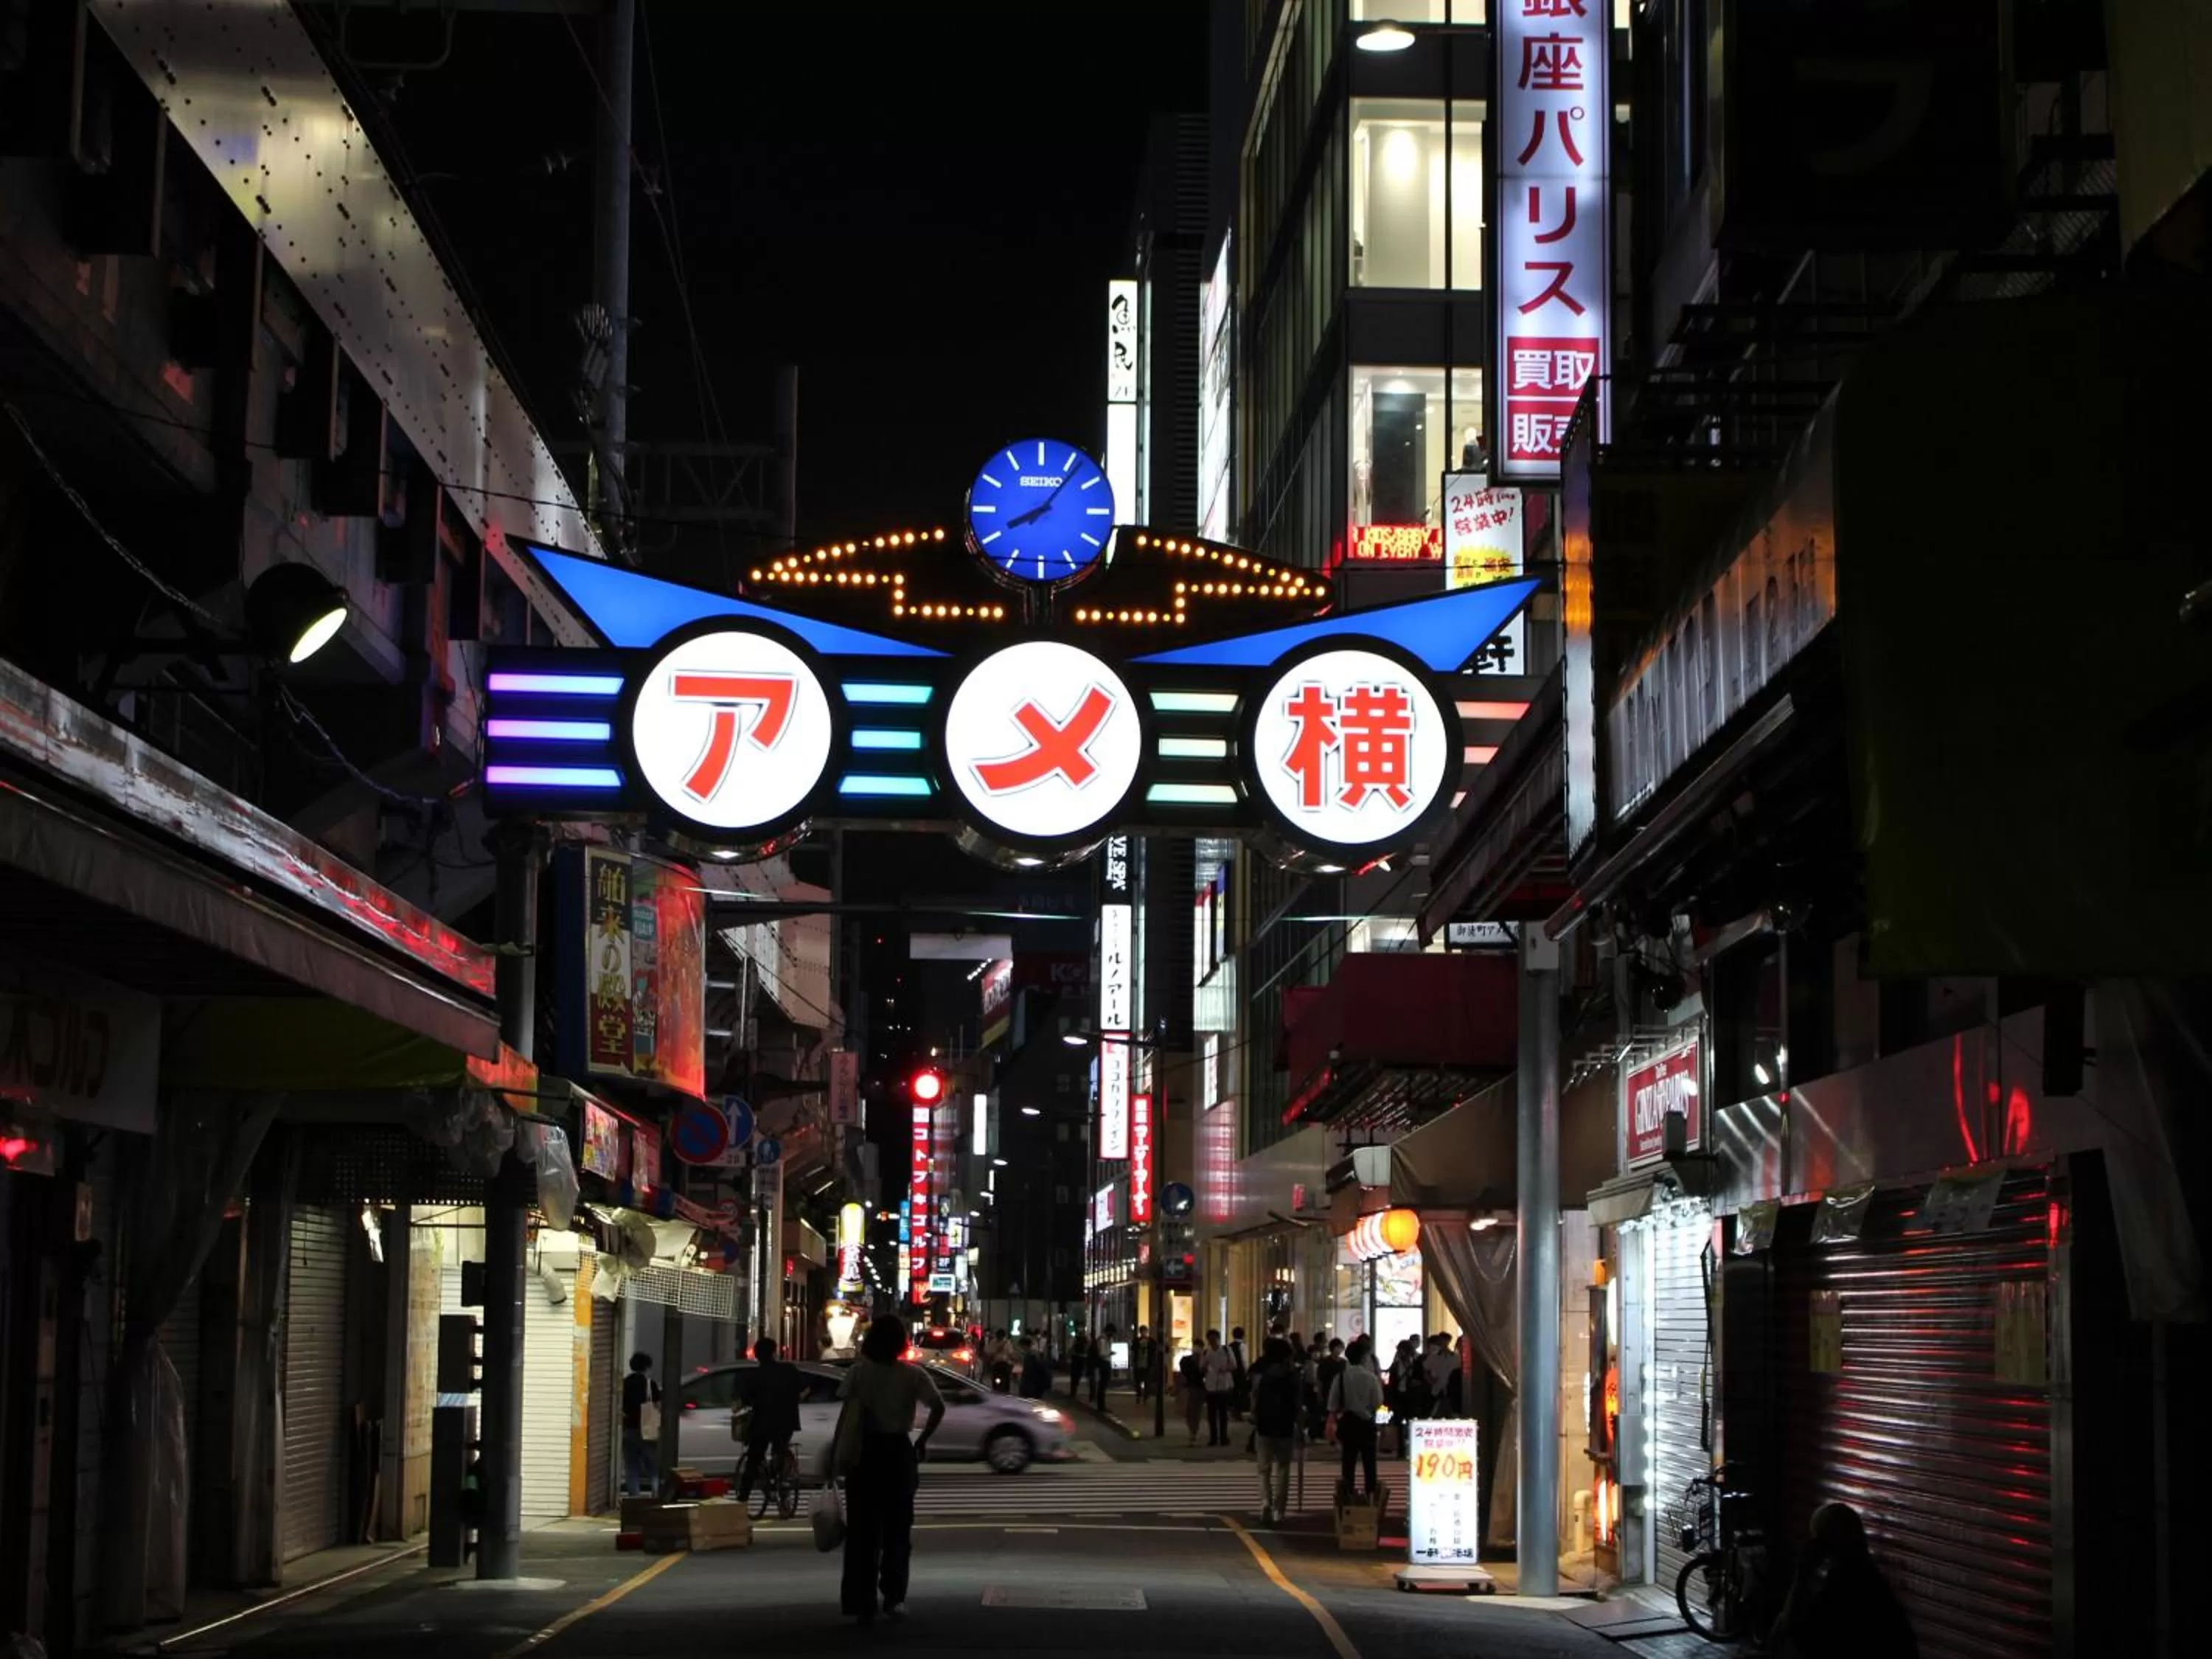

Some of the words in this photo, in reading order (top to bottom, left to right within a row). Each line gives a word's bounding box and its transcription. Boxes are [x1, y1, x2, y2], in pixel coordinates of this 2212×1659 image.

[1517, 0, 1585, 317] 座パリス
[1111, 293, 1137, 371] 魚民
[1512, 349, 1595, 391] 買取
[1020, 476, 1063, 487] SEIKO
[671, 671, 1416, 812] アメ横
[1415, 1452, 1474, 1481] 190円
